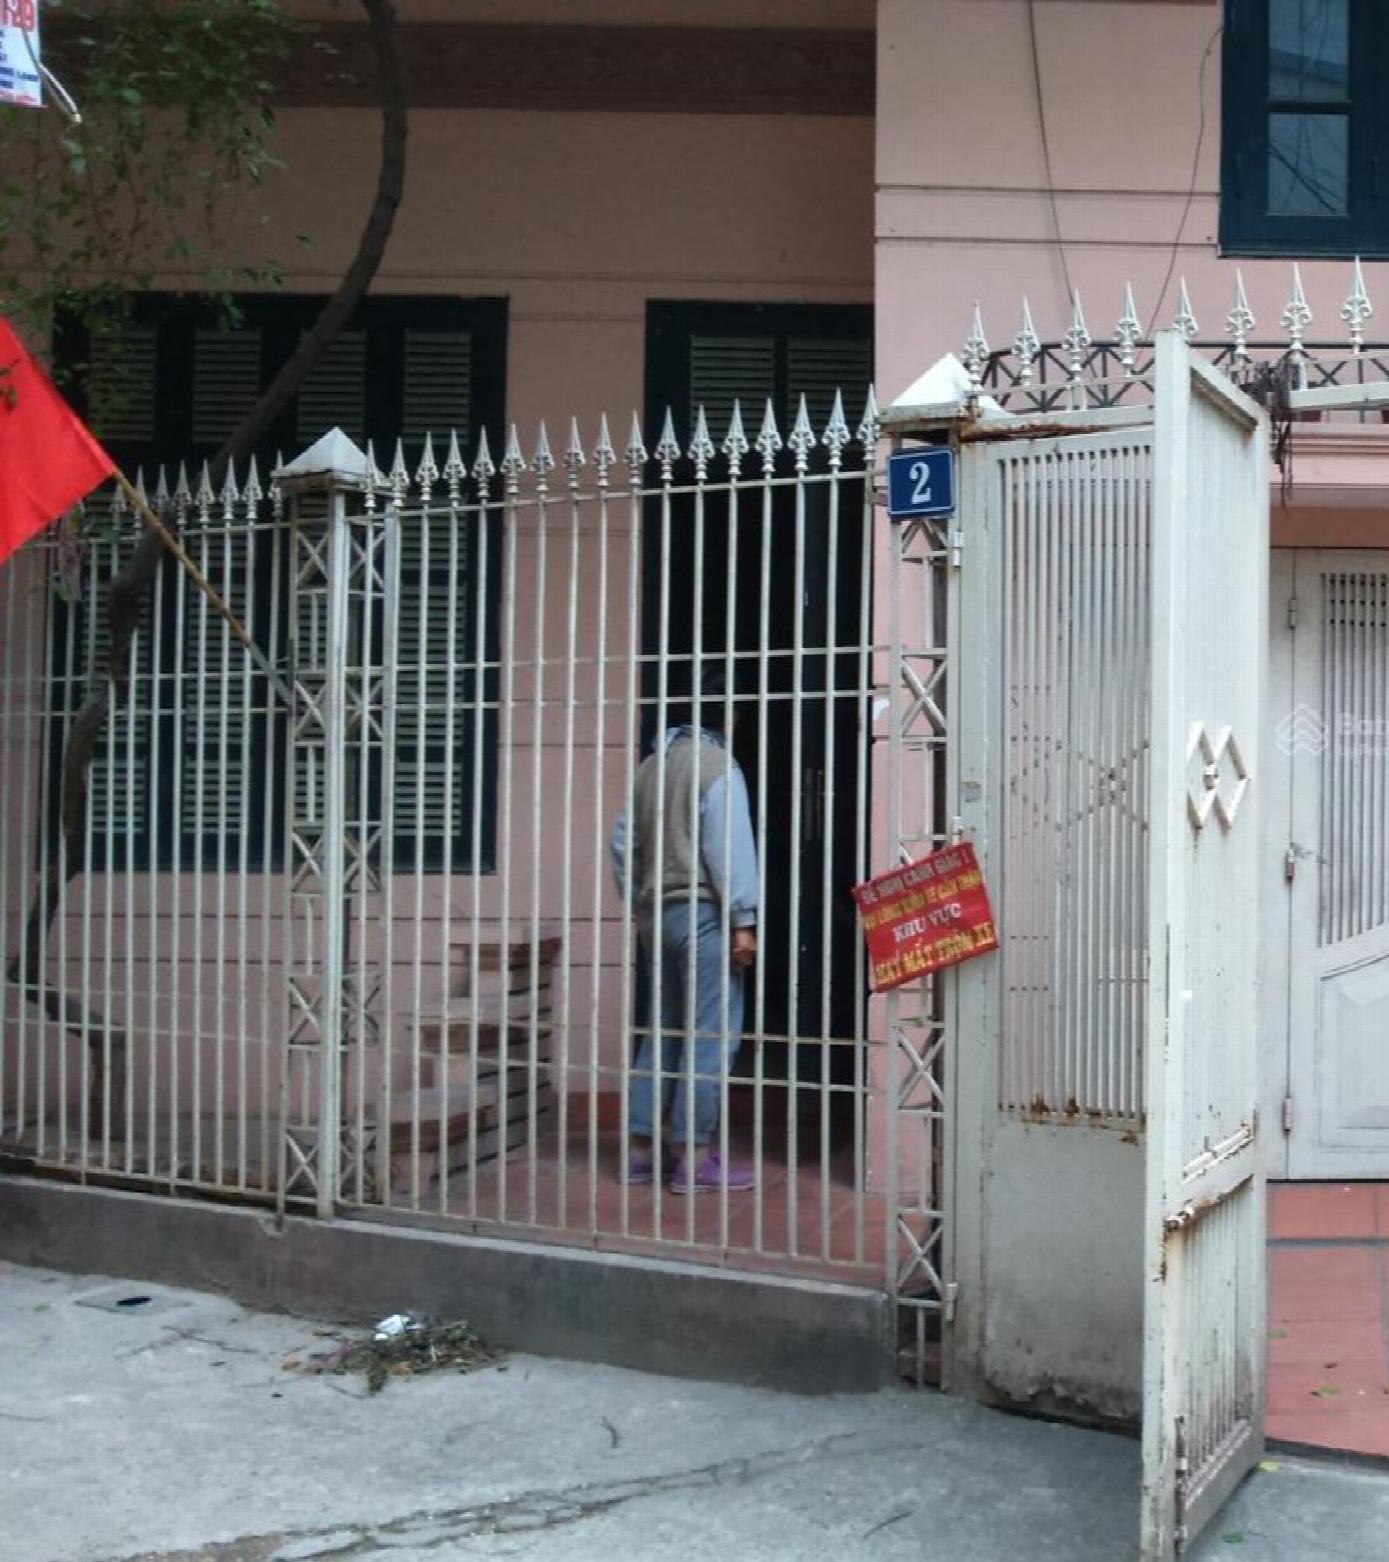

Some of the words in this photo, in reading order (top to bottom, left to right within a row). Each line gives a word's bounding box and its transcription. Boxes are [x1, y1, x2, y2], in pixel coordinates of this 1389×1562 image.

[909, 461, 932, 504] 2
[892, 915, 927, 943] KHU
[928, 903, 962, 926] VỰC
